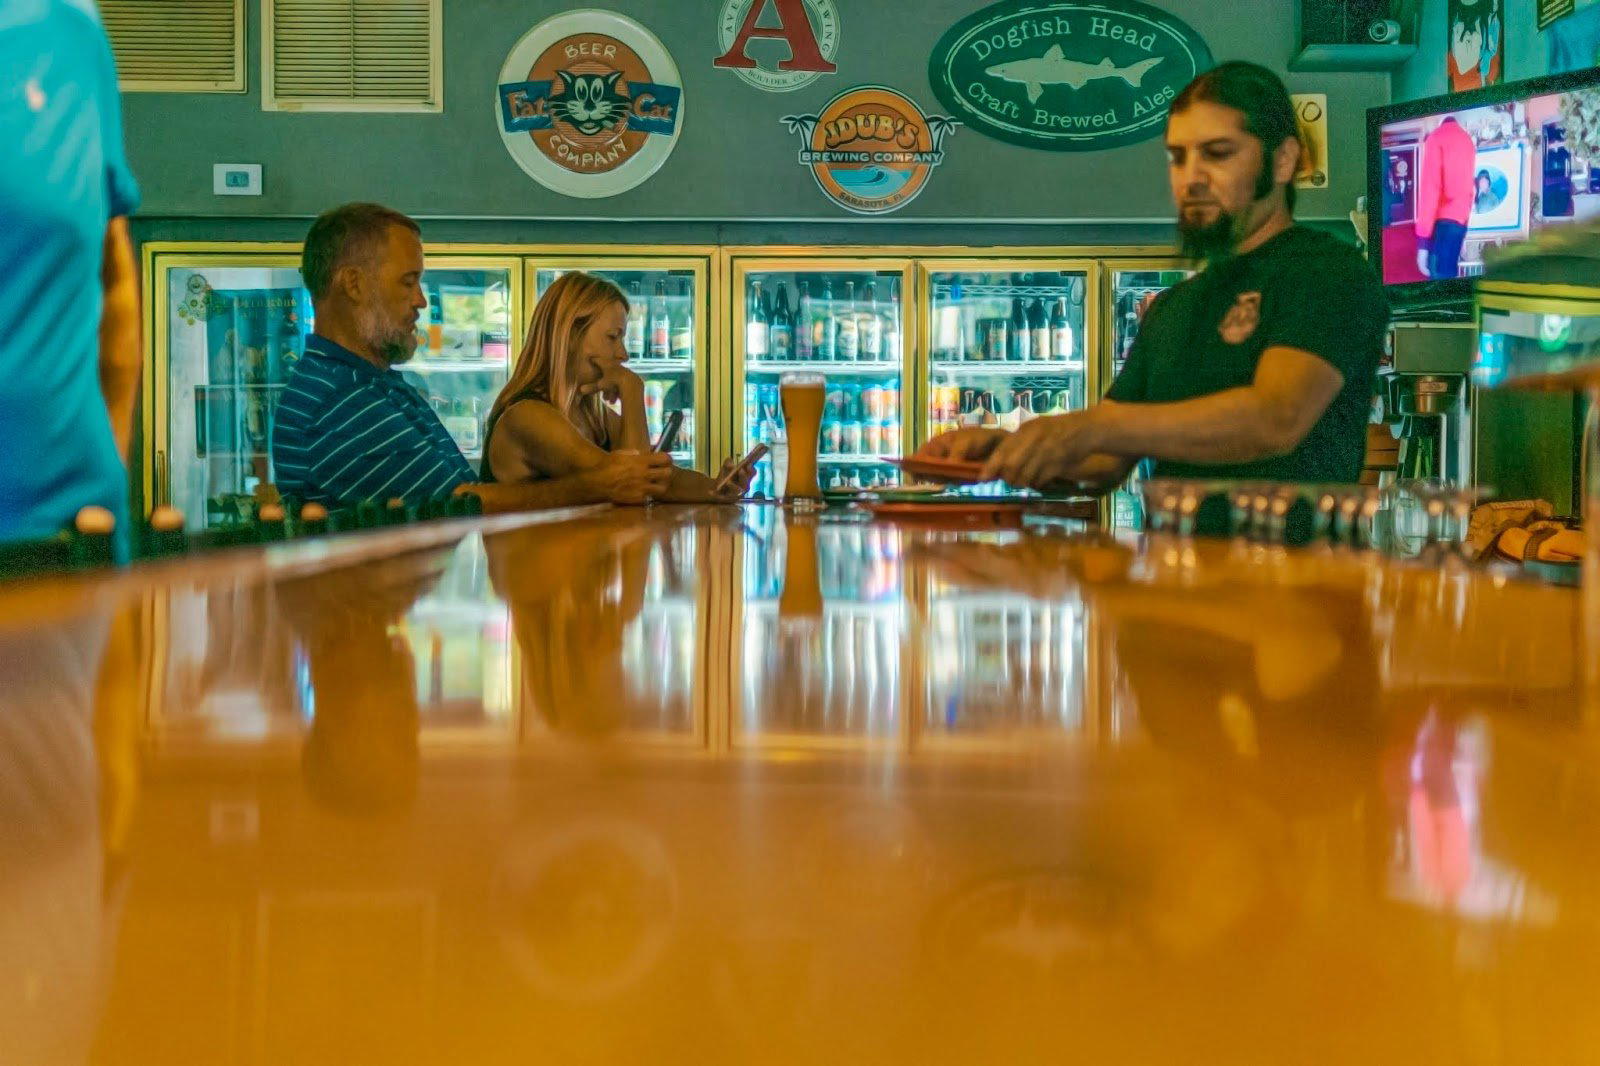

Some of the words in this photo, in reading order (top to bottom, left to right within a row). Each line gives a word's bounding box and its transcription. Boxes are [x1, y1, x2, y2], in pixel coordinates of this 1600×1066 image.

[725, 1, 740, 33] AVE
[817, 0, 833, 52] EWING
[970, 17, 1072, 61] Dogfish
[1089, 17, 1157, 52] Head
[565, 42, 617, 59] BEER
[507, 90, 550, 120] Fat
[632, 93, 673, 119] Cat
[968, 82, 1020, 119] Craft
[1033, 109, 1119, 128] Brewed
[1133, 85, 1175, 118] Ales
[550, 134, 628, 168] COMPANY
[801, 152, 869, 163] BREWING
[873, 152, 942, 163] COMPANY
